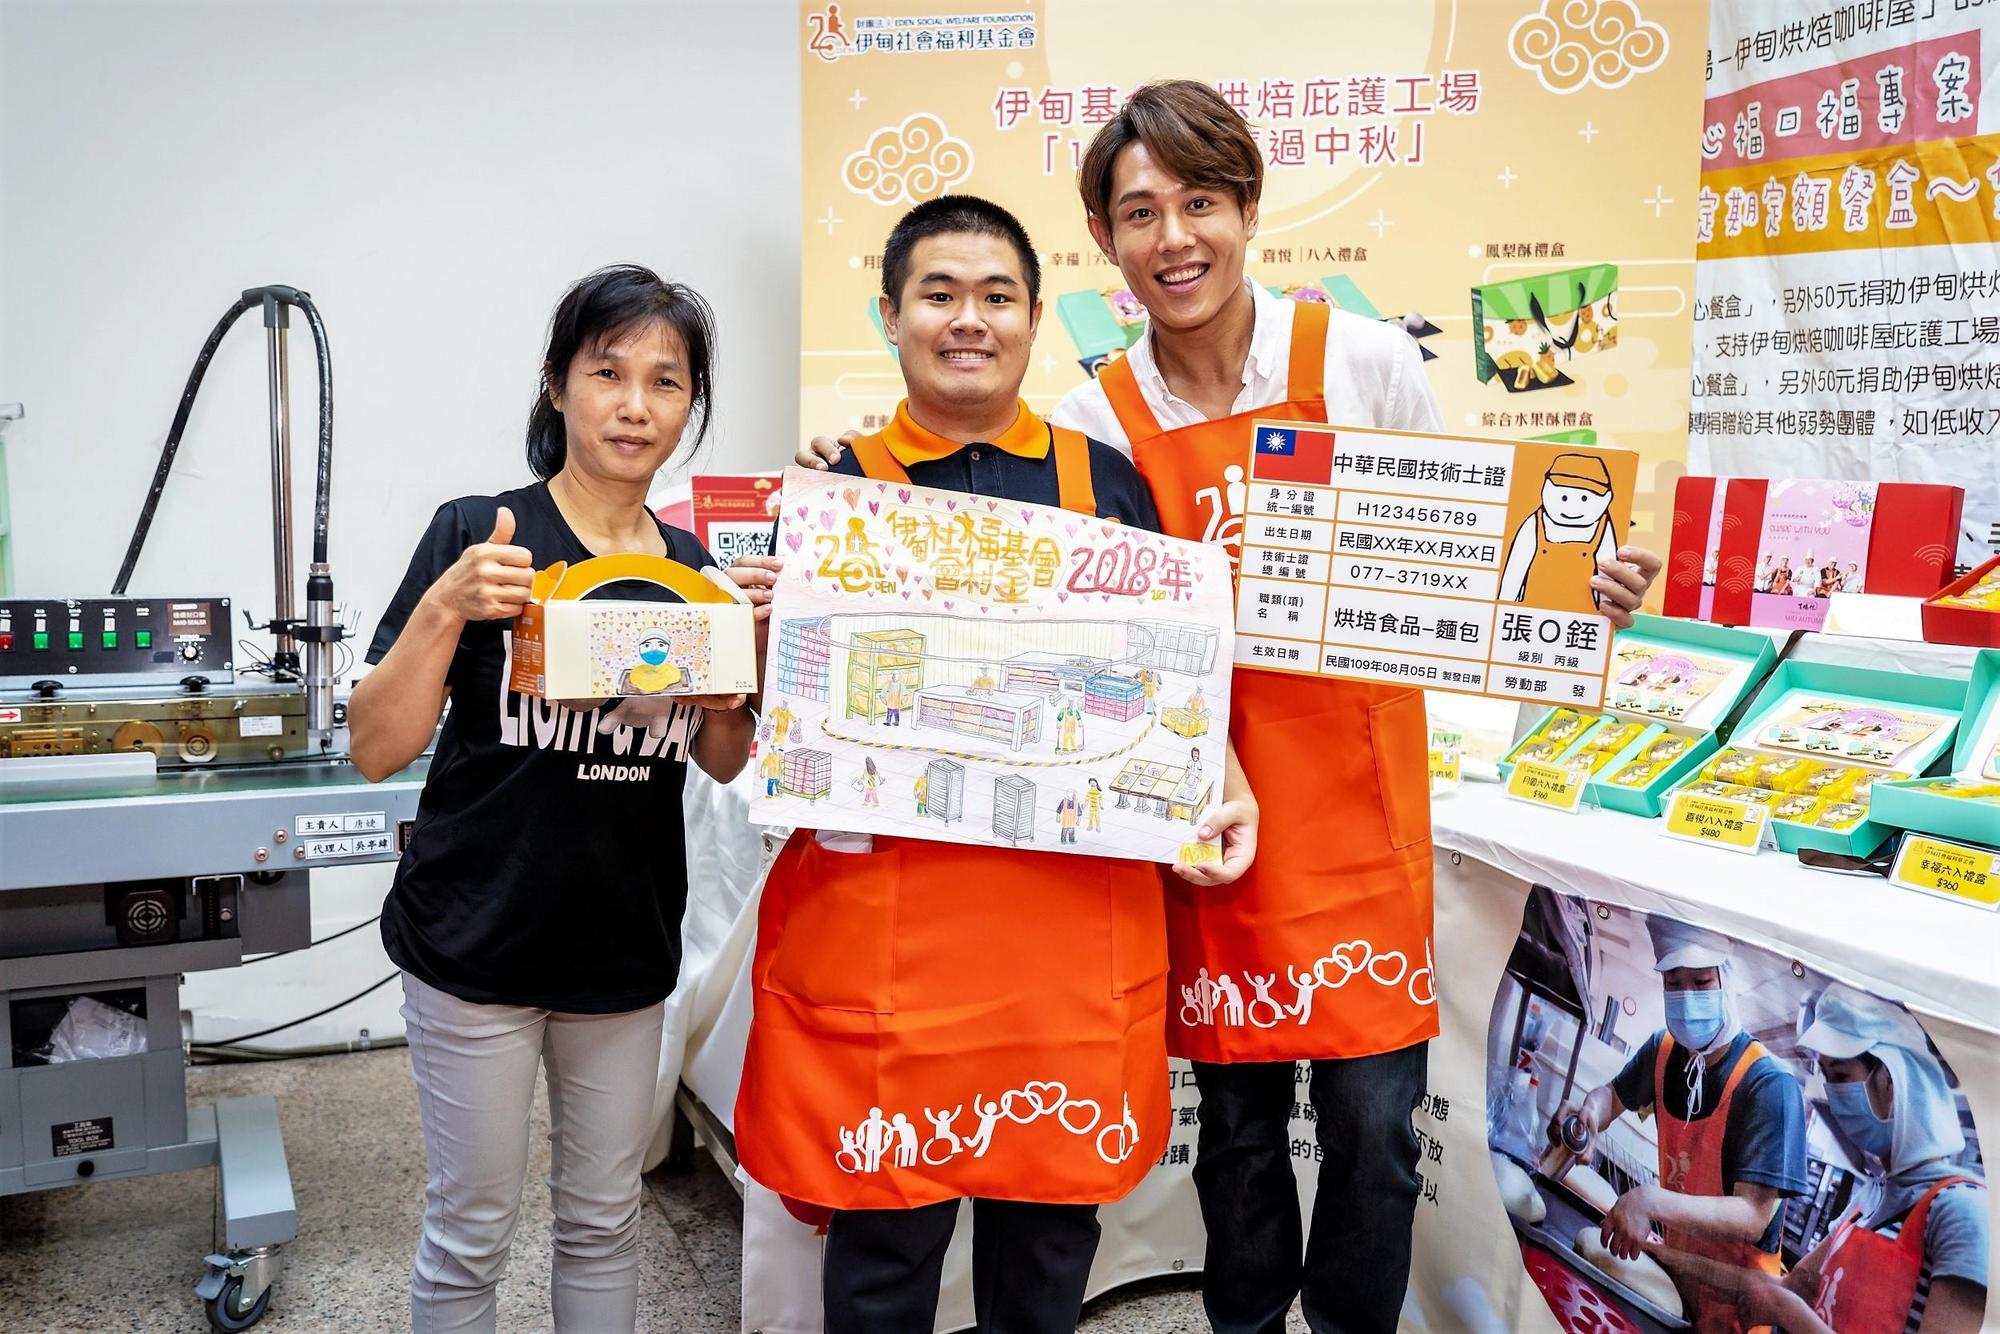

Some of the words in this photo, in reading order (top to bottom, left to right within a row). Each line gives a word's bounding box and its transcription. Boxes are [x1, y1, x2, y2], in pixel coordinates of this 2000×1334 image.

[895, 19, 915, 27] EDEN
[917, 17, 943, 26] SOCIAL
[947, 16, 980, 25] WELFARE
[983, 15, 1034, 23] FOUNDATION
[856, 27, 1035, 52] 伊甸社會福利基金會
[995, 72, 1479, 127] 伊甸基烘焙庇護工場
[1486, 242, 1565, 259] 鳳梨酥禮盒
[1482, 411, 1593, 428] 綜合水果酥禮盒
[1334, 453, 1506, 487] 中華民國技術士證
[1266, 501, 1315, 516] 統一編號
[1357, 502, 1477, 526] H123456789
[1264, 526, 1312, 541] 出生日期
[1339, 532, 1495, 563] 民國XX年XX月XX日
[1262, 550, 1309, 565] 技術士證
[1066, 541, 1193, 602] 2018年
[1350, 565, 1468, 590] 077-3719XX
[1259, 593, 1304, 608] 職類(項)
[1252, 645, 1300, 660] 生效日期
[1518, 651, 1543, 664] 級別
[1554, 655, 1579, 668] 丙級
[1326, 655, 1437, 680] 民國109年08月05日
[1442, 671, 1481, 685] 製發日期
[1504, 676, 1547, 693] 勞動部
[1572, 684, 1586, 698] 發
[577, 764, 651, 781] LONDON
[1700, 827, 1720, 838] $480
[313, 843, 347, 854] 代理人
[1920, 859, 1987, 885] 幸福六入禮盒
[1937, 877, 1959, 891] $360
